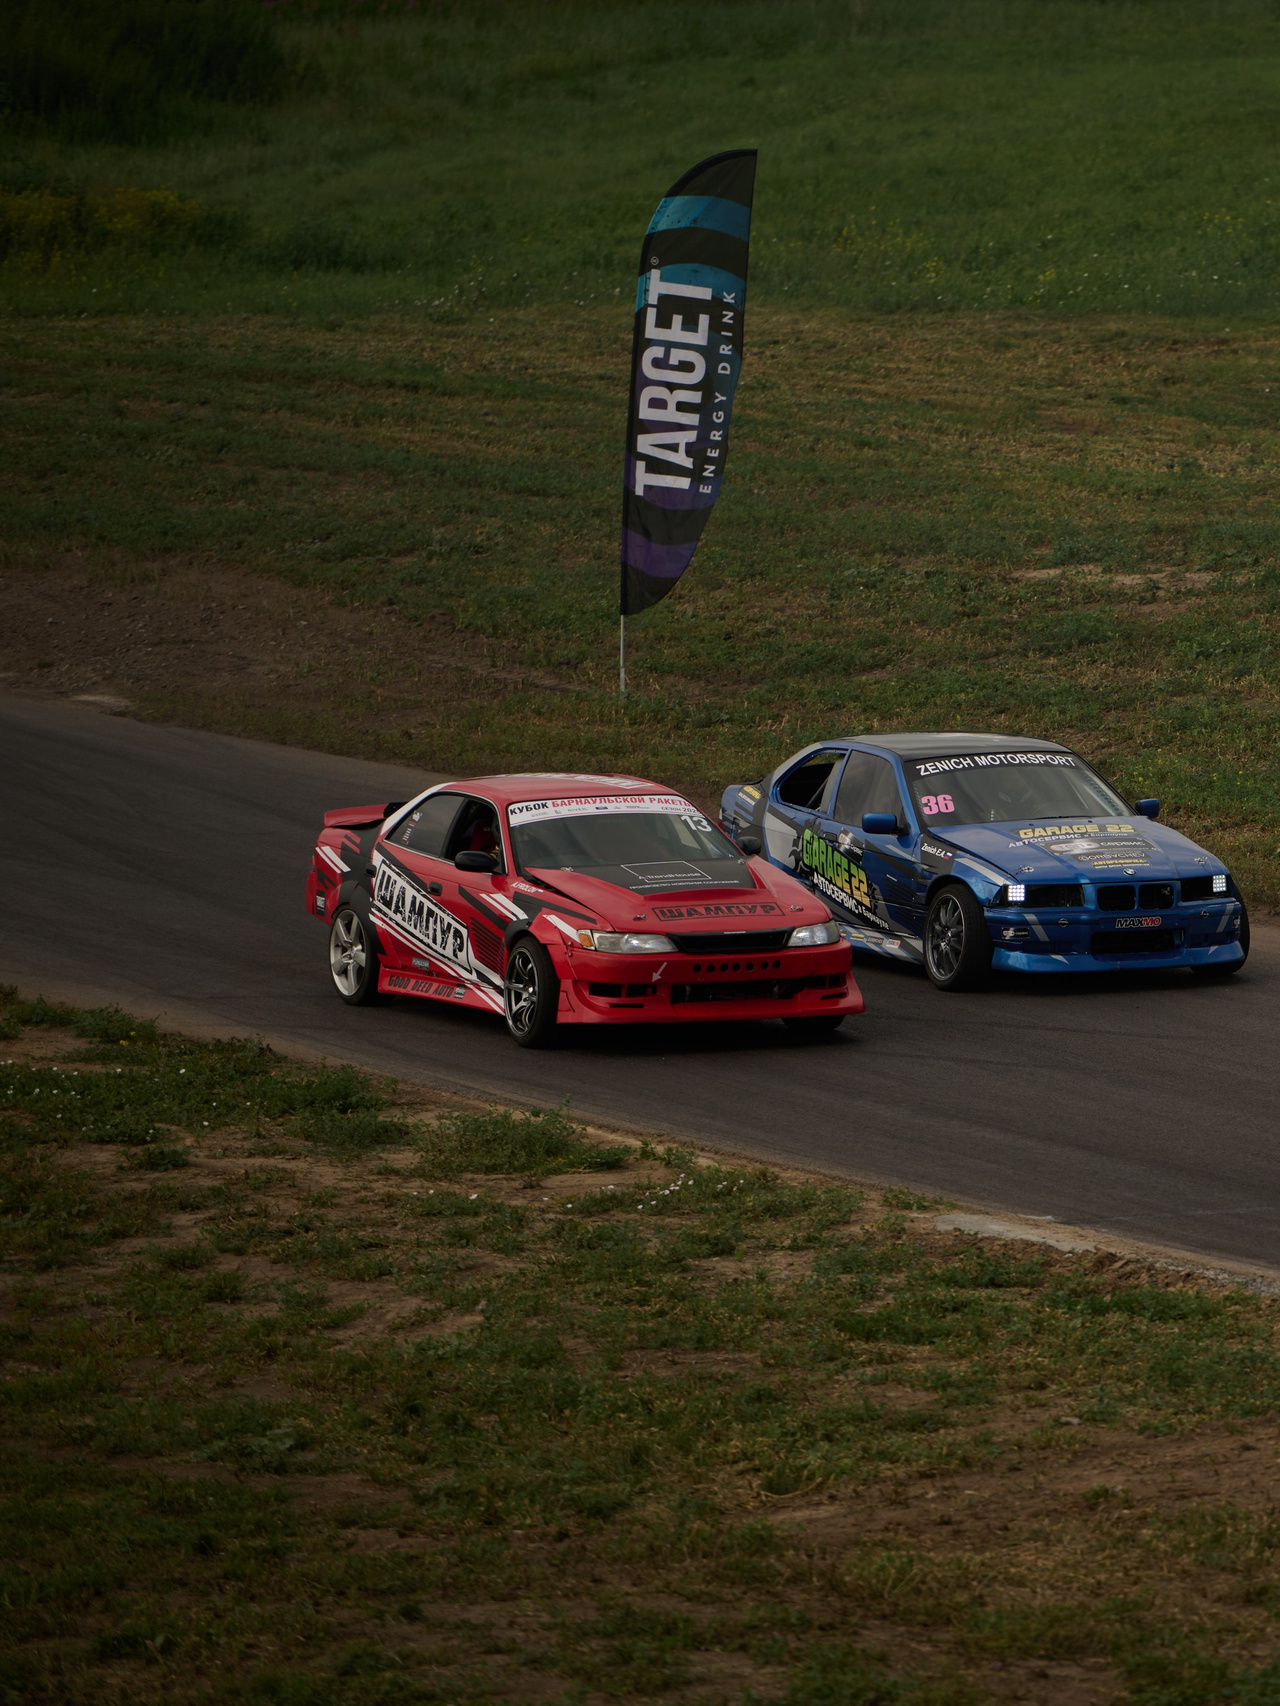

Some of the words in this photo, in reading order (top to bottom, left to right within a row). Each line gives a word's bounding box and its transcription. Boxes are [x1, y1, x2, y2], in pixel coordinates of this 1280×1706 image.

[634, 268, 714, 497] TARGET
[698, 392, 729, 495] ENERGY
[718, 289, 738, 376] DRINK
[916, 756, 974, 777] ZENICH
[974, 753, 1076, 770] MOTORSPORT
[510, 802, 549, 815] КУБОК
[552, 796, 645, 808] БАРНАУЛЬСКОЙ
[920, 794, 955, 816] 36
[681, 815, 712, 832] 13
[1019, 824, 1099, 839] GARAGE
[1105, 824, 1135, 833] 22
[1008, 833, 1081, 848] АВТОСЕРВИС
[803, 828, 850, 893] GARAGE
[850, 864, 871, 908] 22
[812, 871, 859, 914] АВТОСЕРВИС
[375, 869, 465, 960] ШАМПУР
[659, 904, 777, 920] ШАМПУР
[1115, 916, 1162, 929] MAXMO
[388, 975, 411, 990] GOOD
[411, 979, 433, 994] DEED
[433, 984, 455, 998] AUTO
